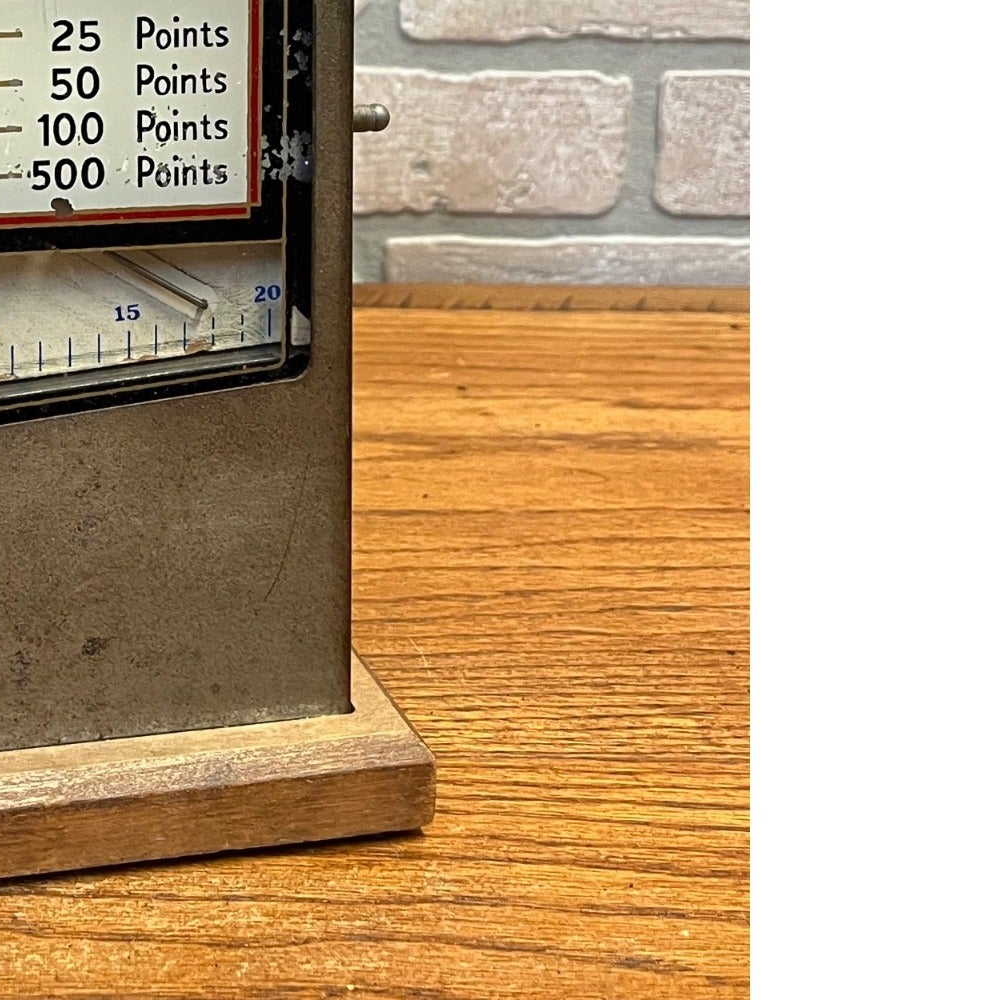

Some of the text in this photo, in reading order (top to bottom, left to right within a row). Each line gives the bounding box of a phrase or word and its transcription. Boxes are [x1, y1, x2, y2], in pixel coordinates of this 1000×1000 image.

[52, 20, 100, 52] 25
[137, 16, 229, 49] Points
[51, 66, 99, 100] 50
[137, 64, 226, 95] Points
[38, 112, 103, 146] 100
[137, 109, 227, 143] Points
[32, 157, 104, 190] 500
[138, 155, 227, 187] Points
[254, 285, 281, 303] 20
[114, 304, 141, 323] 15
